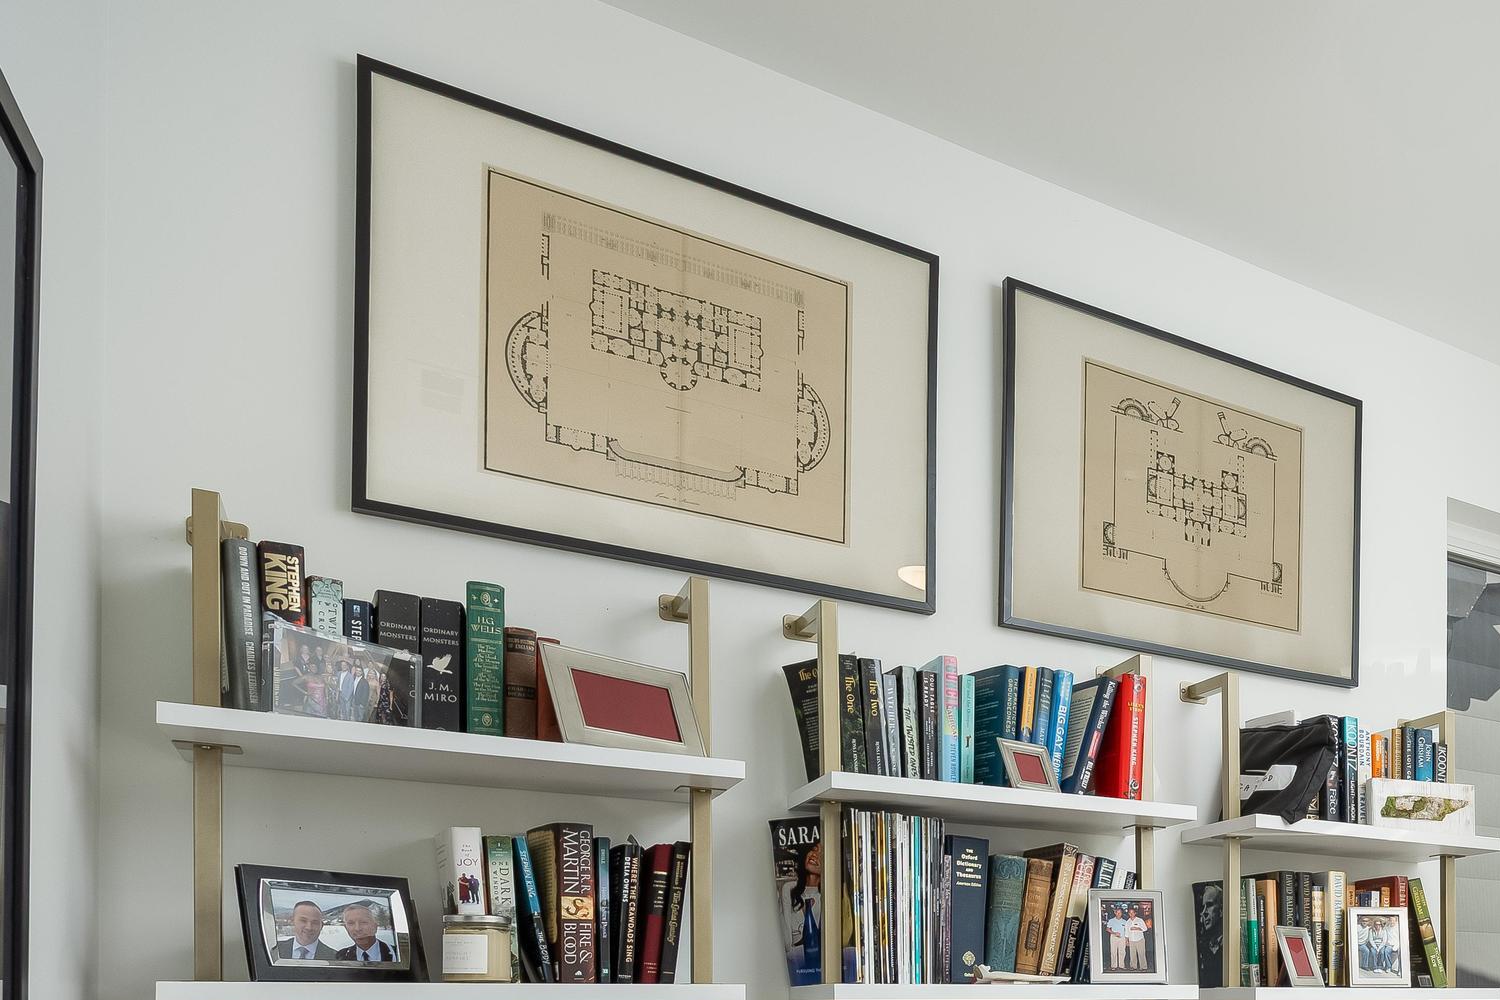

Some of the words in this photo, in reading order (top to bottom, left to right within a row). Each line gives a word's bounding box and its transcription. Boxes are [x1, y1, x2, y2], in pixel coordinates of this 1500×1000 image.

[238, 546, 247, 567] DOWN
[239, 568, 249, 581] AND
[264, 552, 288, 611] KING
[287, 555, 301, 612] STEPHEN
[241, 582, 250, 595] OUT
[242, 595, 250, 604] IN
[243, 604, 254, 636] PARADISE
[379, 621, 417, 632] ORDINARY
[470, 624, 501, 635] WELLS
[379, 631, 417, 641] MONSTERS
[422, 636, 460, 646] MONSTERS
[423, 627, 459, 637] ORDINARY
[245, 641, 258, 670] CHARLES
[844, 675, 856, 692] The
[869, 680, 879, 696] The
[1104, 680, 1116, 700] Killing
[424, 692, 458, 703] MIRO
[847, 693, 857, 714] One
[871, 698, 880, 717] Two
[1102, 699, 1111, 709] the
[1057, 705, 1067, 725] BIG
[1096, 709, 1108, 730] Witches
[905, 725, 916, 757] TWISTED
[1054, 727, 1064, 750] GAY
[1131, 716, 1139, 749] STEPHEN
[1347, 724, 1357, 771] KOONTZ
[909, 757, 918, 777] ONES
[1329, 788, 1337, 814] Face
[563, 829, 579, 894] MARTIN
[579, 830, 591, 872] GEORGE
[457, 858, 479, 867] JOY
[520, 850, 531, 879] STEPHEN
[630, 857, 638, 883] WHERE
[956, 861, 982, 869] Dictionary
[492, 870, 500, 901] WINDOW
[499, 867, 512, 905] DARK
[525, 880, 535, 898] KING
[622, 878, 630, 903] OWENS
[629, 885, 637, 900] THE
[1285, 874, 1293, 895] DAVID
[1334, 875, 1343, 898] DAVID
[1412, 886, 1423, 915] GRISHAM
[626, 902, 636, 943] CRAWDADS
[1069, 919, 1078, 935] Peter
[564, 922, 577, 965] BLOOD
[579, 923, 592, 948] FIRE
[539, 944, 551, 965] BODY
[580, 949, 592, 964] &
[625, 944, 634, 963] SING
[1065, 935, 1077, 959] Jenkins
